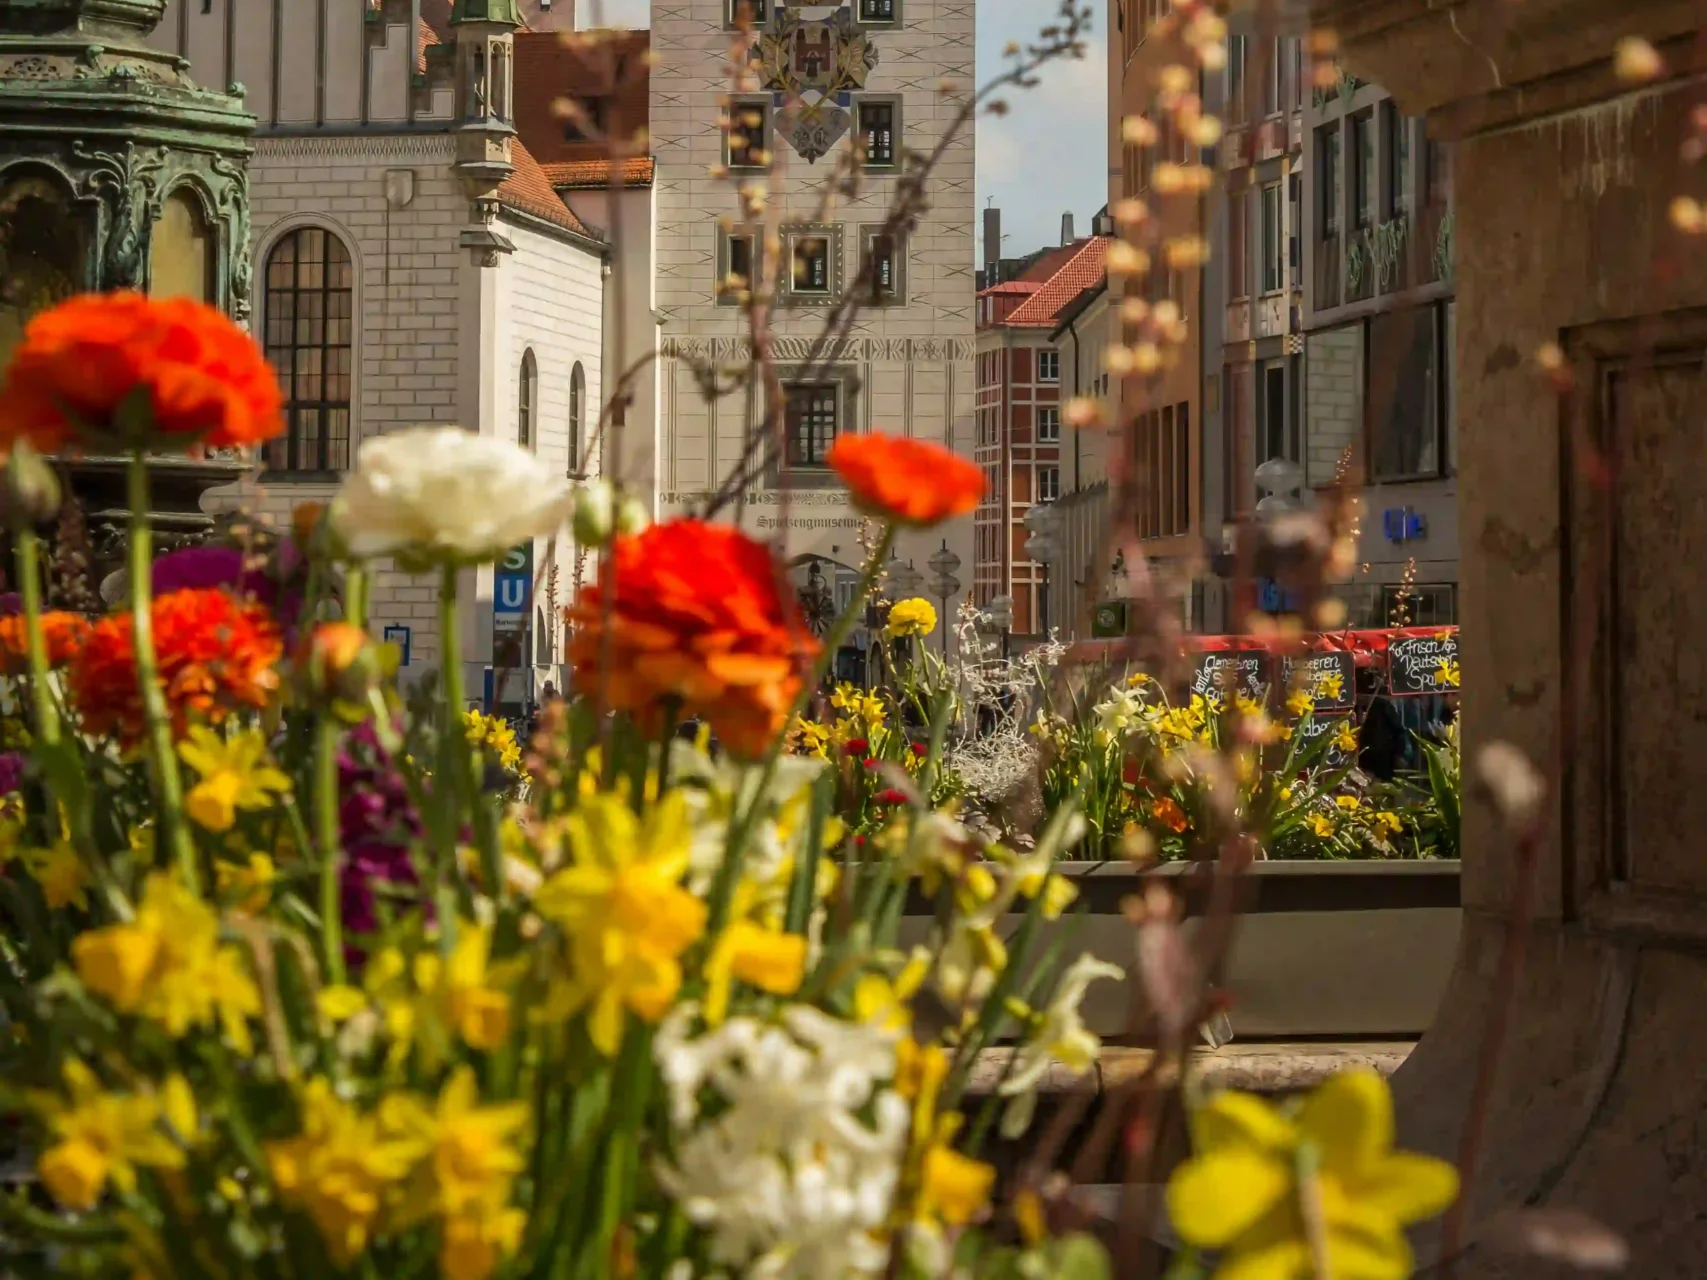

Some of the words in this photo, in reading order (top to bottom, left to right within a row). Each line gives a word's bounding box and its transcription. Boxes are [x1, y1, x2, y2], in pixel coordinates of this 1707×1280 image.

[503, 544, 526, 570] S
[502, 579, 525, 608] U
[1205, 654, 1259, 671] Clemetinen
